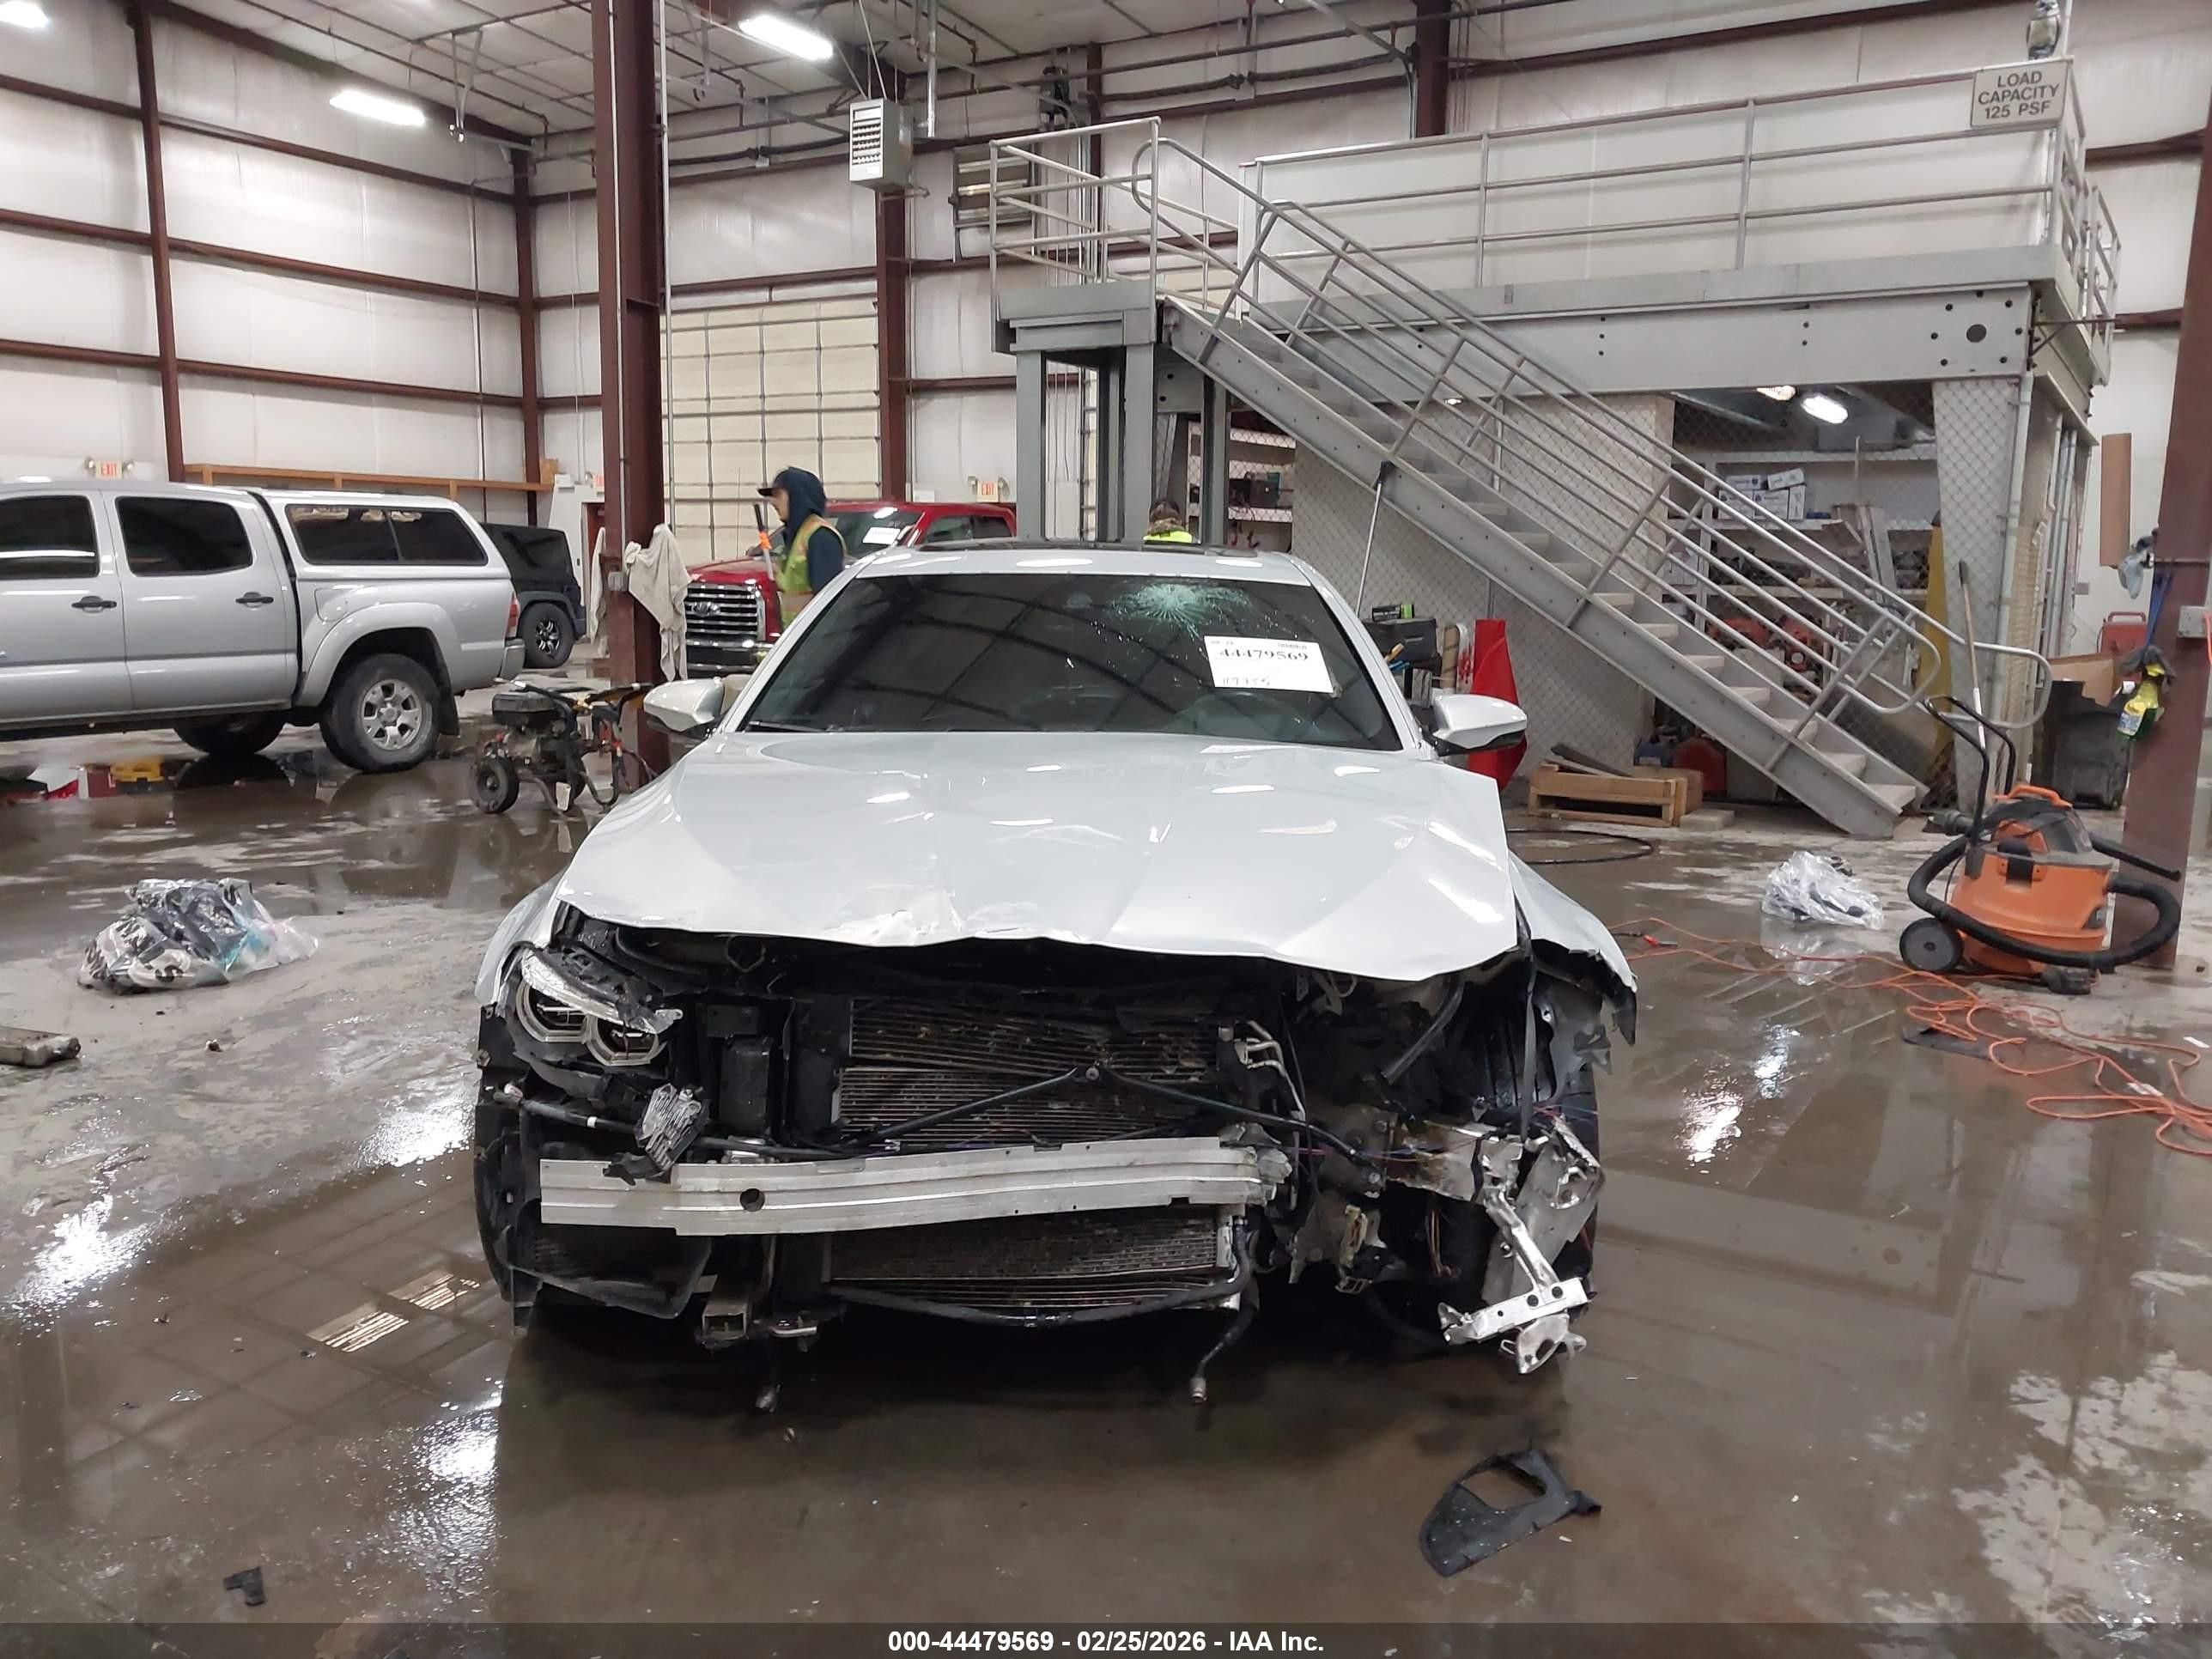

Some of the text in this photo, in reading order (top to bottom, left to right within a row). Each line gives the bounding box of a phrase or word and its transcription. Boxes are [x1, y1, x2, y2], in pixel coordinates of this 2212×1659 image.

[1997, 70, 2043, 88] LOAD
[1978, 83, 2060, 106] CAPACITY
[1984, 100, 2051, 119] 125 PSF
[100, 462, 118, 477] EXIT
[981, 482, 994, 495] EXIT
[1219, 647, 1309, 660] 44479569
